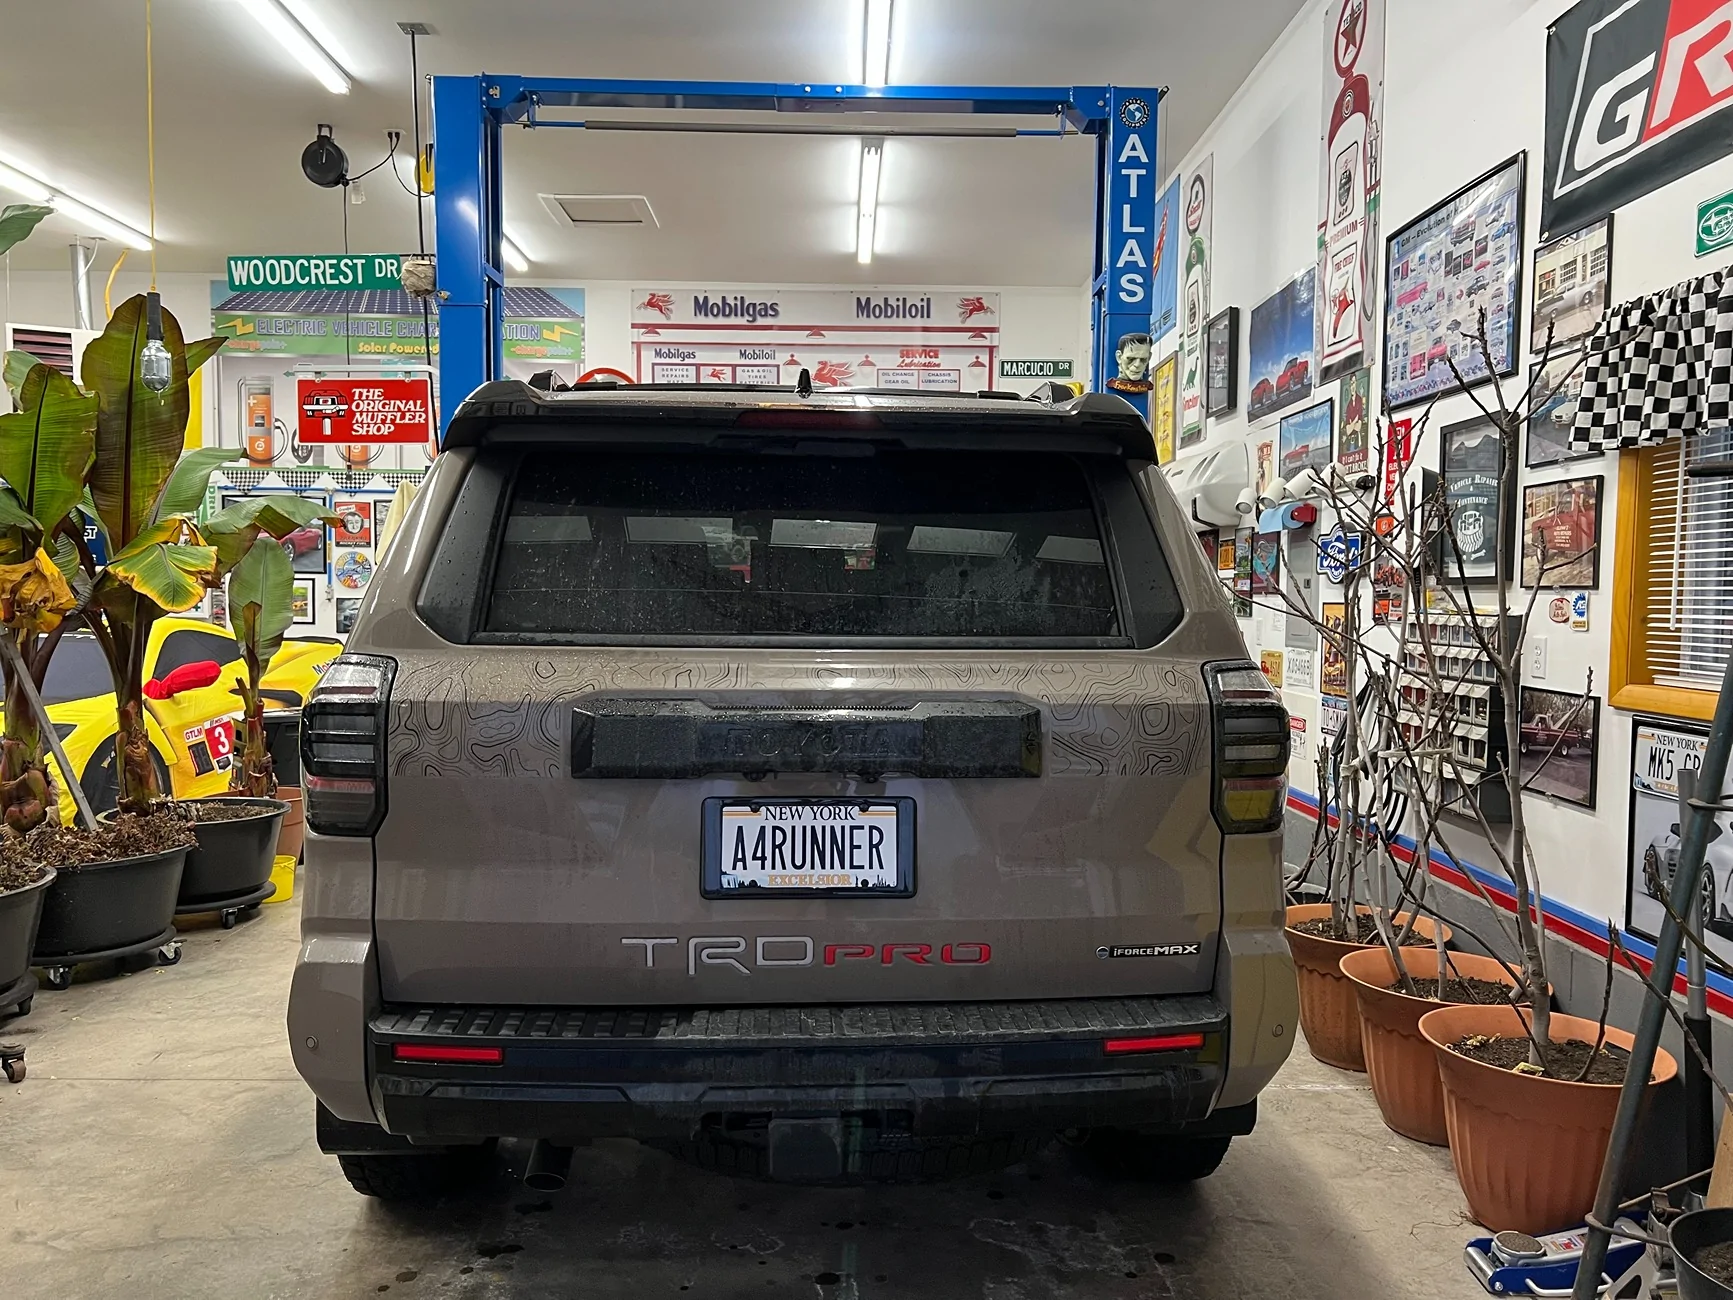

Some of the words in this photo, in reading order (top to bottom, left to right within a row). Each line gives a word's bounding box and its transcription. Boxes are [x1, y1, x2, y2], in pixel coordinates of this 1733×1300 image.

[1574, 9, 1733, 172] GR
[1116, 133, 1149, 303] ATLAS
[1329, 220, 1358, 247] PREMIUM
[230, 259, 366, 286] WOODCREST
[374, 258, 398, 278] DR
[693, 295, 780, 323] Mobilgas
[856, 296, 932, 319] Mobiloil
[257, 318, 327, 335] ELECTRIC
[331, 320, 393, 337] VEHICLE
[358, 342, 386, 353] Solar
[654, 348, 696, 361] Mobilgas
[739, 349, 776, 360] Mobiloil
[899, 349, 940, 359] SERVICE
[1003, 362, 1054, 376] MARCUCIO
[1058, 362, 1070, 370] DR
[351, 388, 384, 400] THE
[351, 400, 426, 412] ORIGINAL
[351, 412, 426, 424] MUFFLER
[351, 424, 395, 435] SHOP
[185, 727, 203, 741] GTLM
[214, 726, 230, 754] 3
[1656, 734, 1676, 747] NEW
[1676, 737, 1699, 752] YORK
[1648, 745, 1675, 781] MK5
[764, 806, 806, 821] NEW
[807, 806, 857, 821] YORK
[731, 825, 885, 871] A4RUNNER
[767, 874, 853, 886] EXCELSIOR
[621, 936, 815, 976] TRD
[823, 942, 992, 968] PRO
